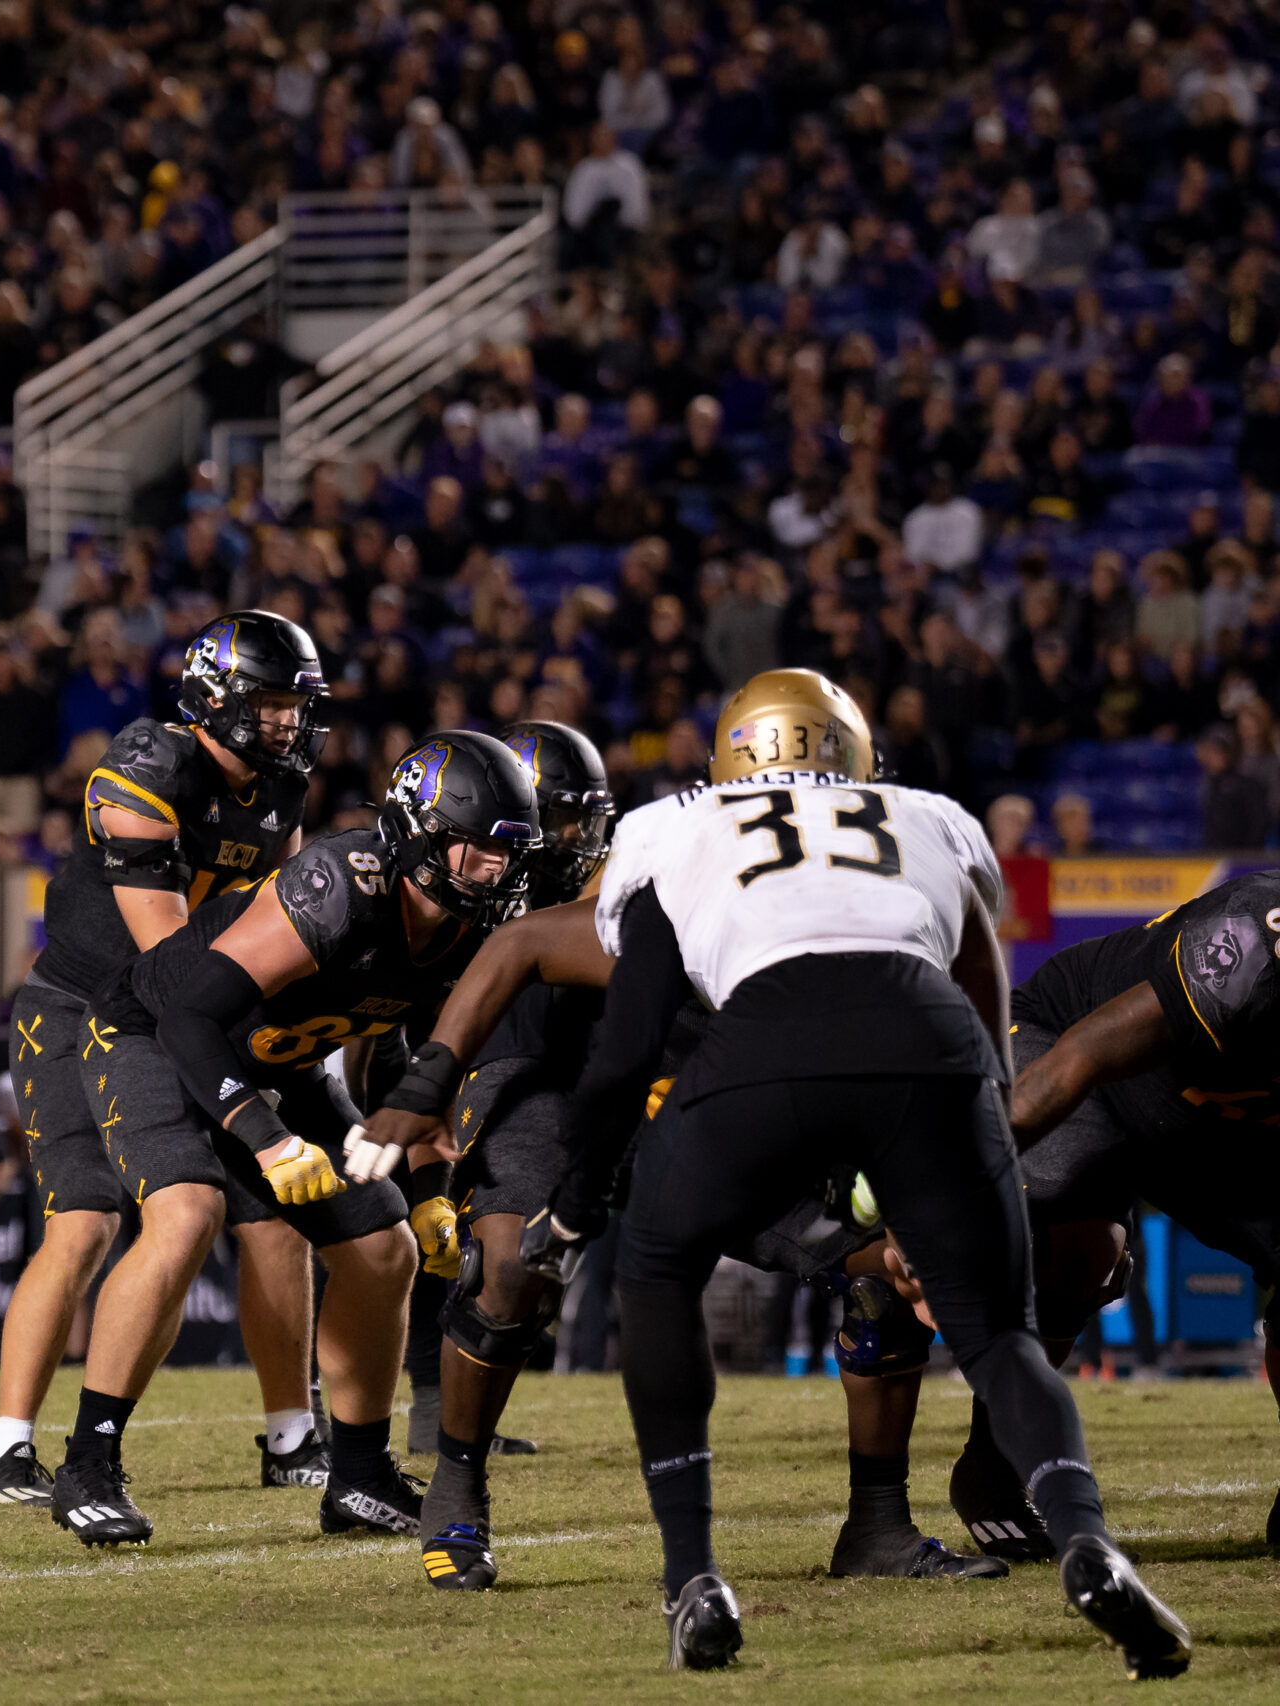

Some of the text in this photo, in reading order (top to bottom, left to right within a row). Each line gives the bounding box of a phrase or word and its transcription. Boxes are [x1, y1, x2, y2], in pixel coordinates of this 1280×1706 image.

[419, 747, 440, 765] ECU
[767, 726, 809, 761] 33
[259, 820, 280, 832] adidas
[718, 788, 903, 890] 33
[215, 839, 260, 870] ECU
[348, 850, 388, 896] 85
[349, 996, 412, 1016] ECU
[218, 1081, 244, 1101] adidas
